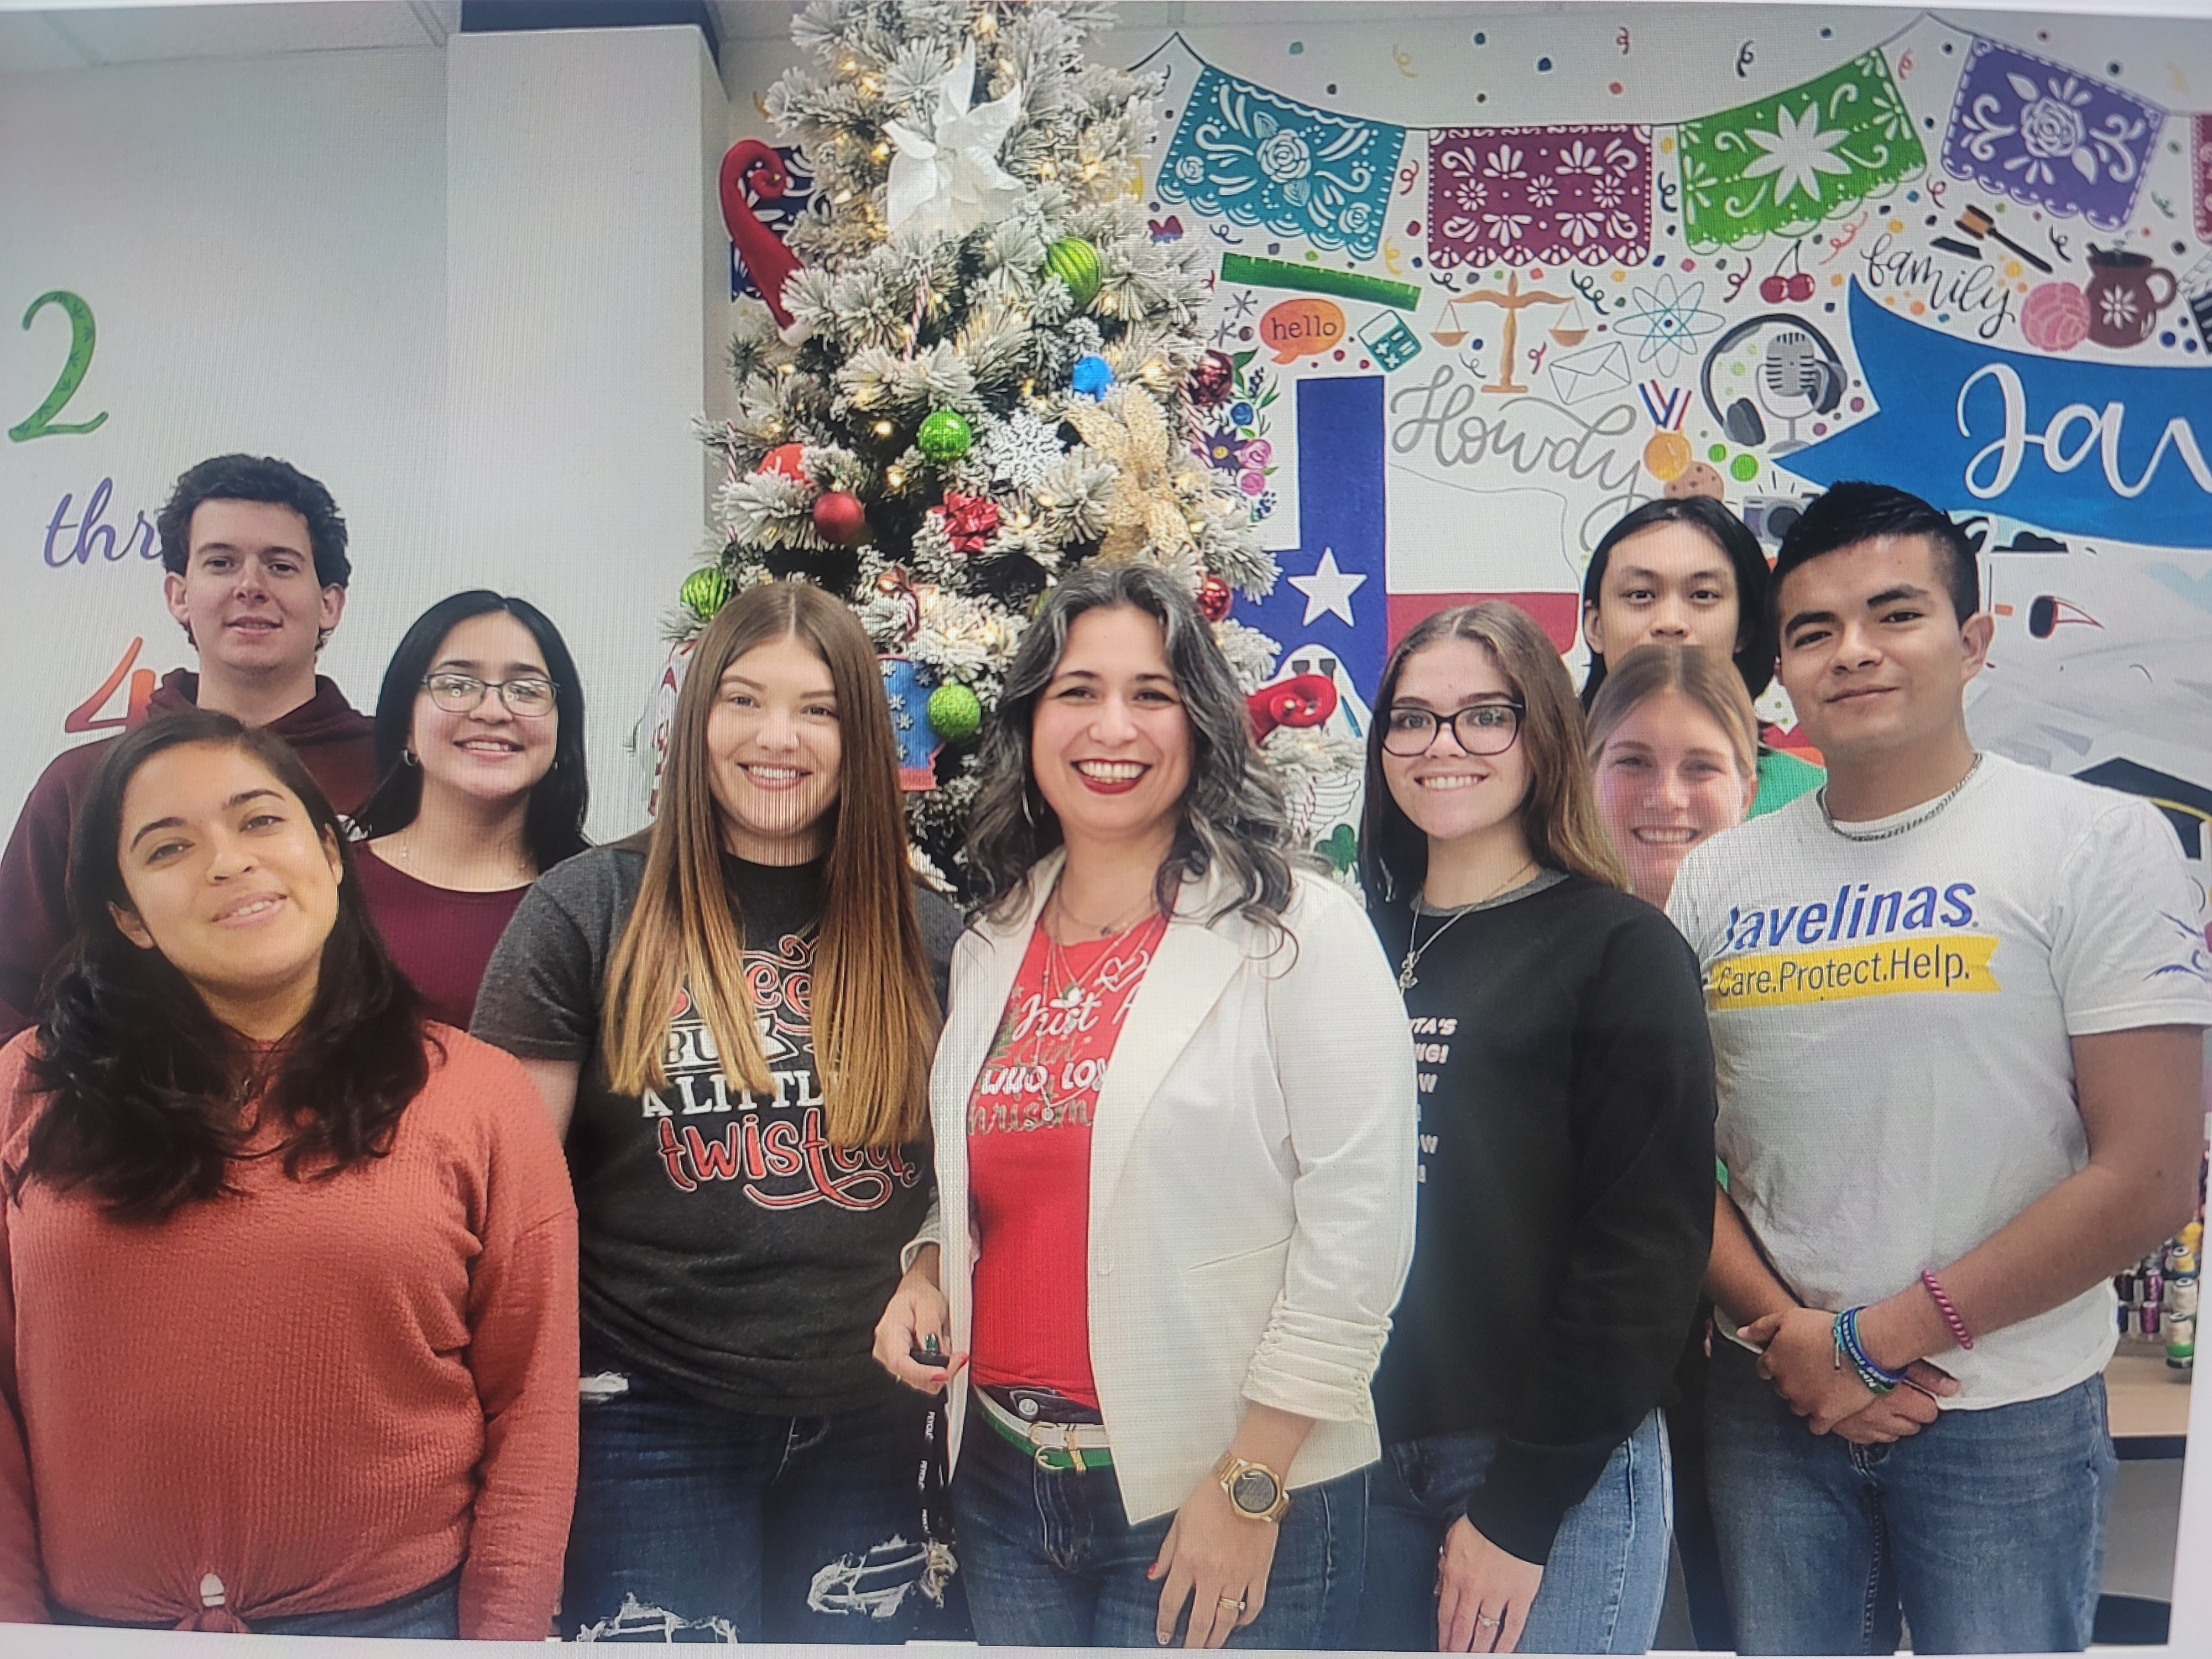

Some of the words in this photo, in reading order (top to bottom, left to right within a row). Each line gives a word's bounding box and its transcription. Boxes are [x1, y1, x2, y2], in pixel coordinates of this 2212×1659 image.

[1271, 315, 1338, 341] hello
[1860, 234, 2016, 338] family
[9, 290, 108, 442] 2
[1390, 364, 1655, 552] Howdy
[64, 636, 157, 734] 4
